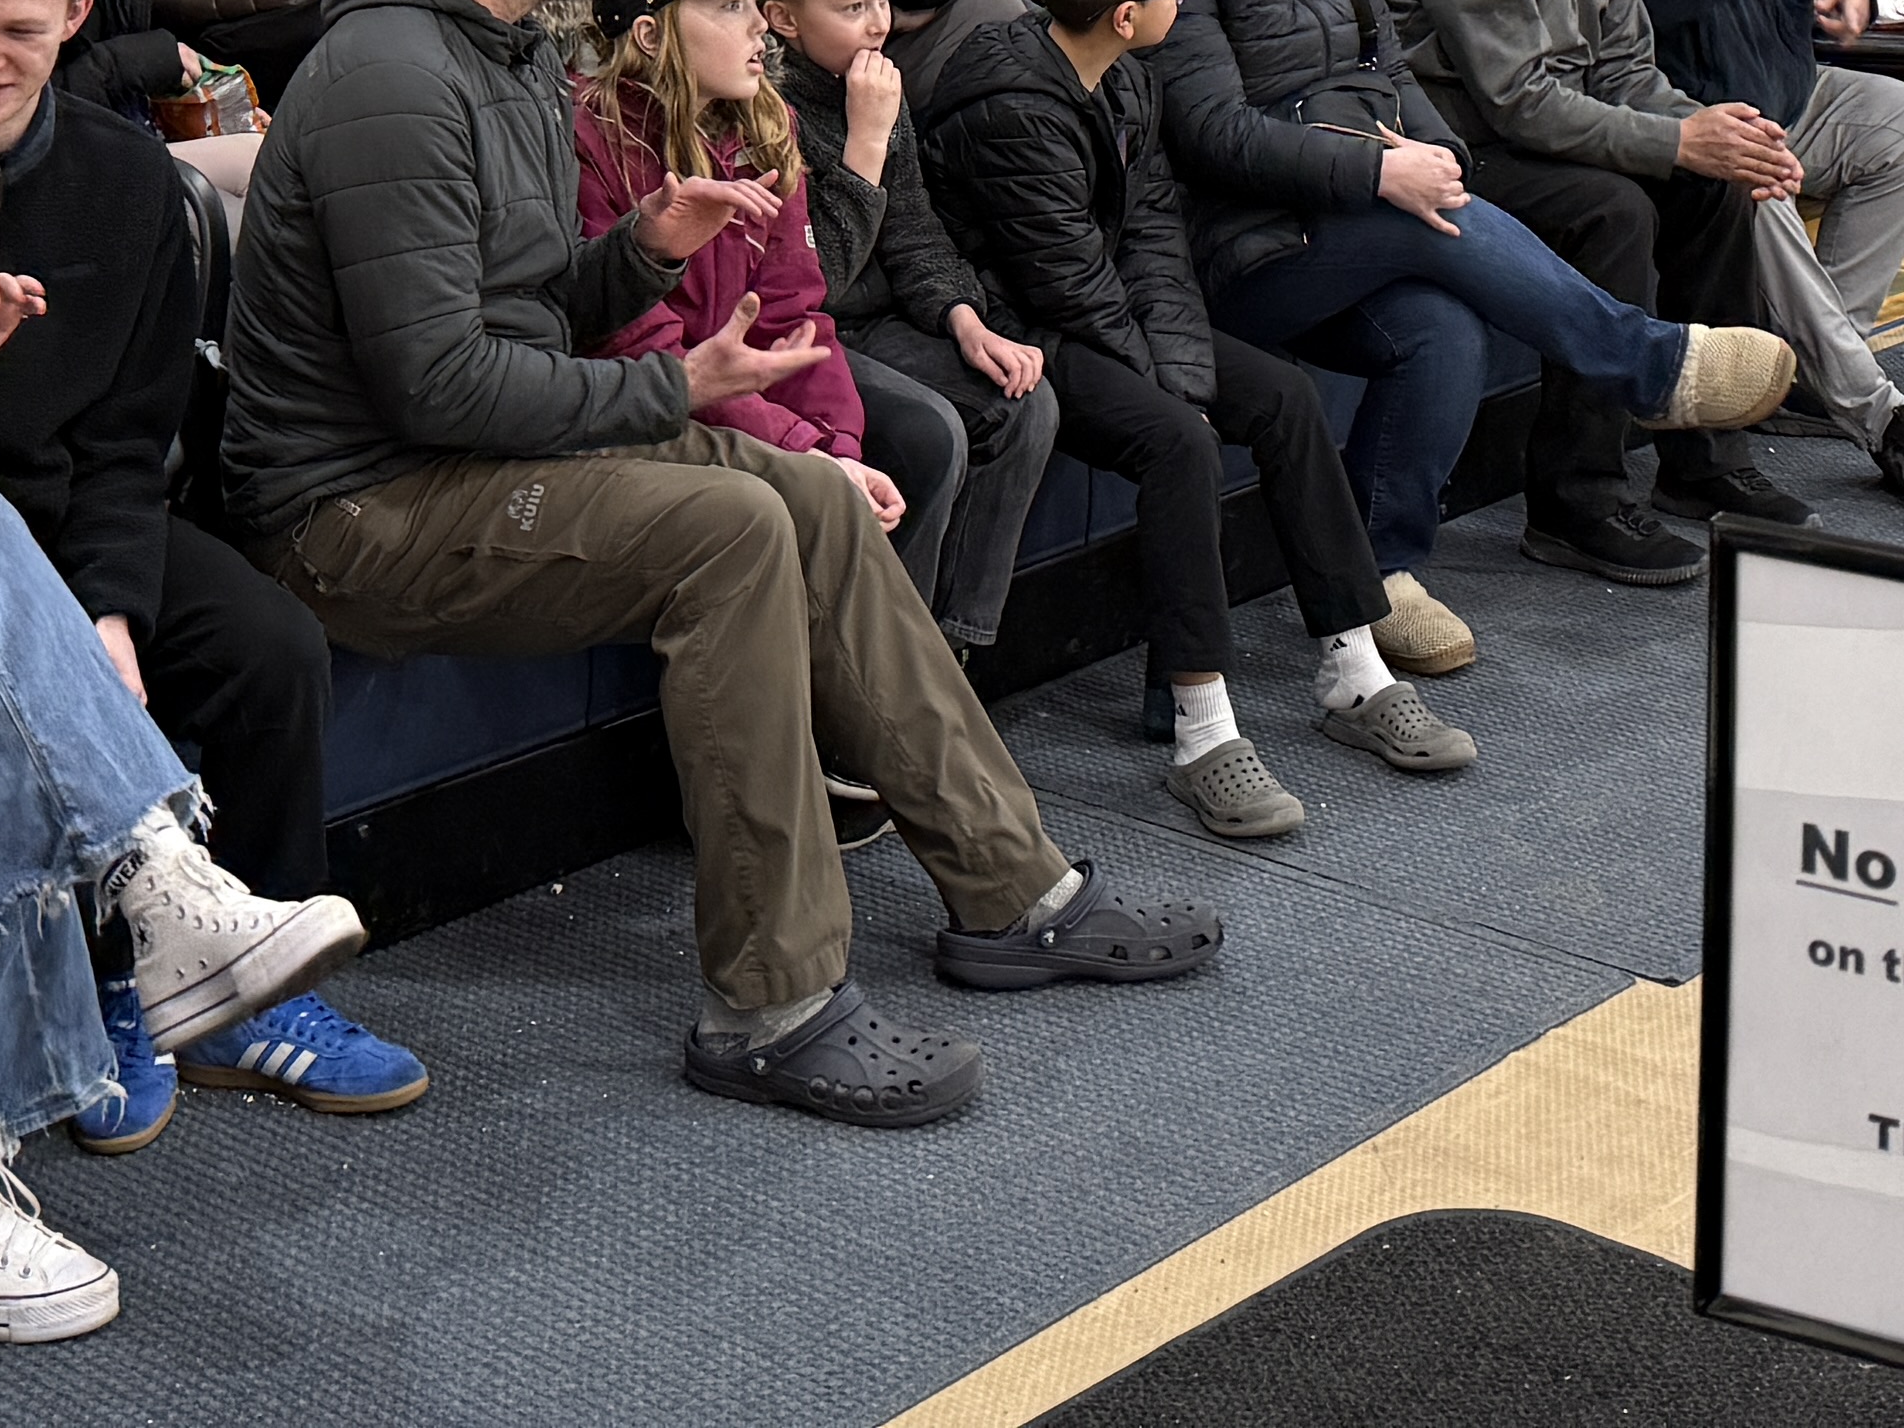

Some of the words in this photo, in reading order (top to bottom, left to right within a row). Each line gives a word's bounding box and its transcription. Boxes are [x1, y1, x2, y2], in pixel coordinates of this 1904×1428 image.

[519, 483, 545, 531] KUIU
[1797, 822, 1898, 892] No
[1808, 937, 1866, 975] on
